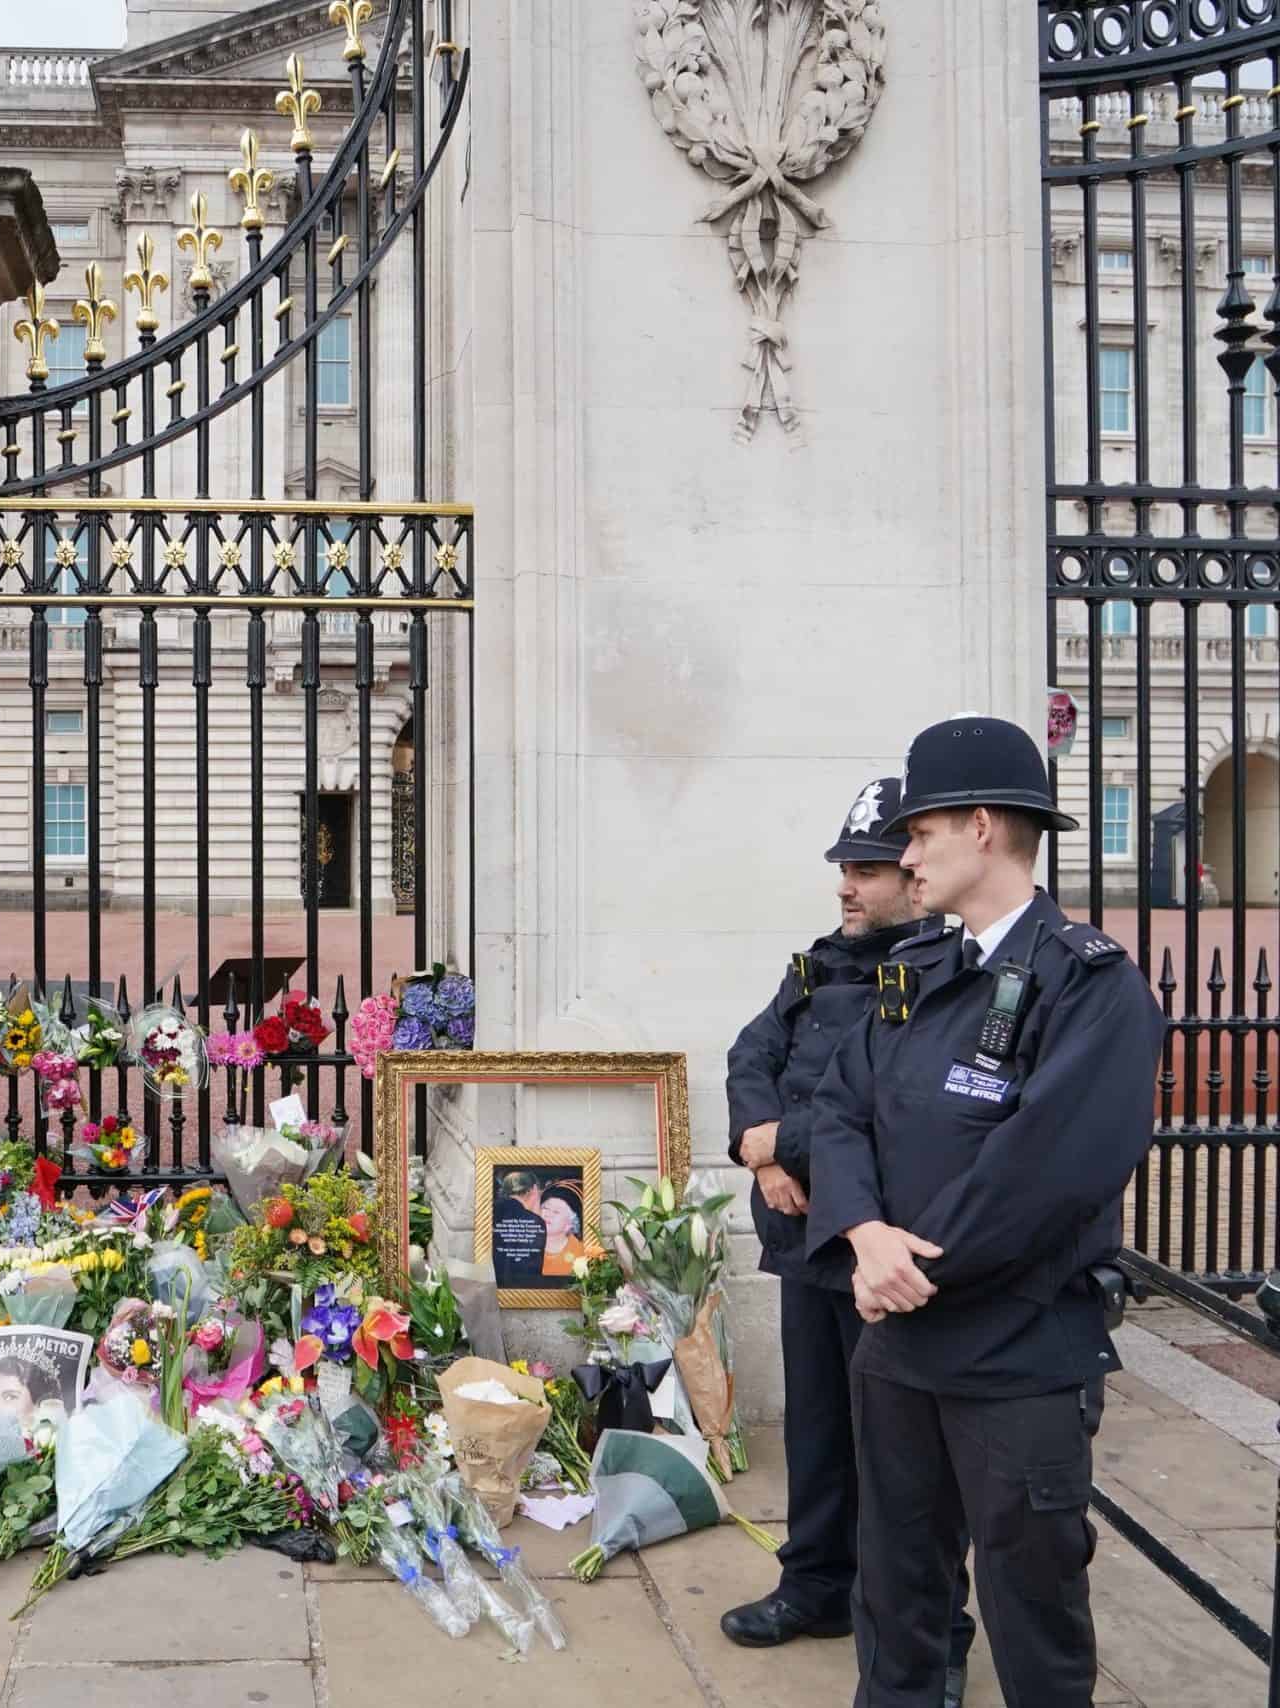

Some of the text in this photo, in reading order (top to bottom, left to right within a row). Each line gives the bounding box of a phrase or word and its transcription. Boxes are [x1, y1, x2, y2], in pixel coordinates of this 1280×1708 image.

[944, 1082, 1002, 1102] POLICE OFFICER
[32, 1336, 79, 1357] METRO
